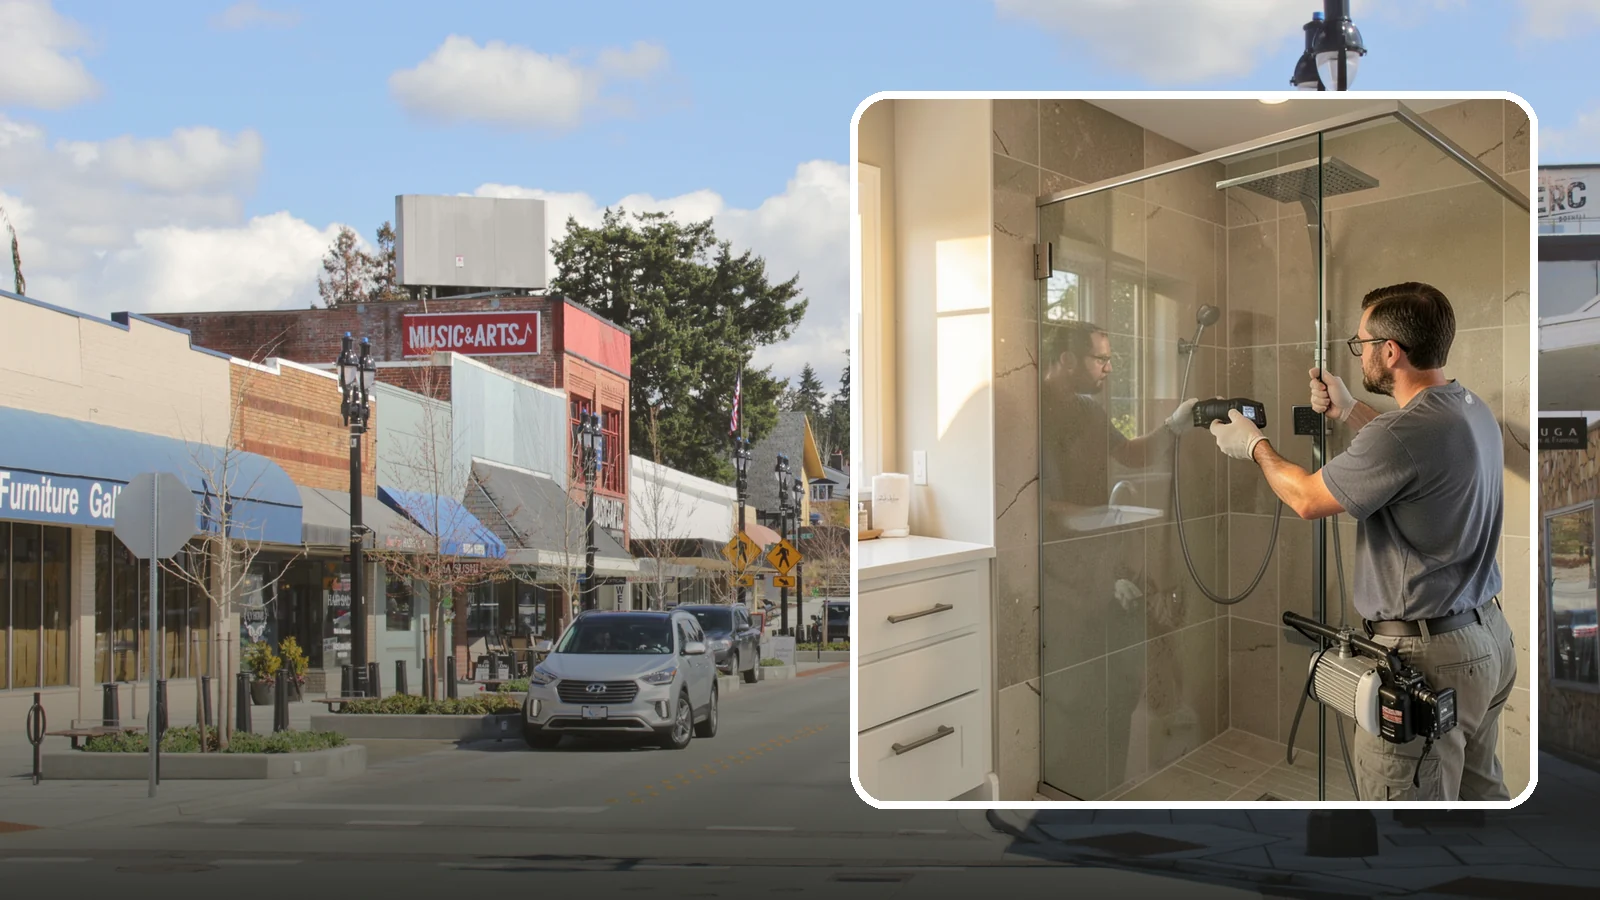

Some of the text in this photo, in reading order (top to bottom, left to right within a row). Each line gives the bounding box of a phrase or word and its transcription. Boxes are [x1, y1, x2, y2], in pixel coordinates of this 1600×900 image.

[408, 323, 520, 348] MUSIC&ARTS
[0, 471, 79, 515] Furniture
[454, 562, 479, 574] SUSHI
